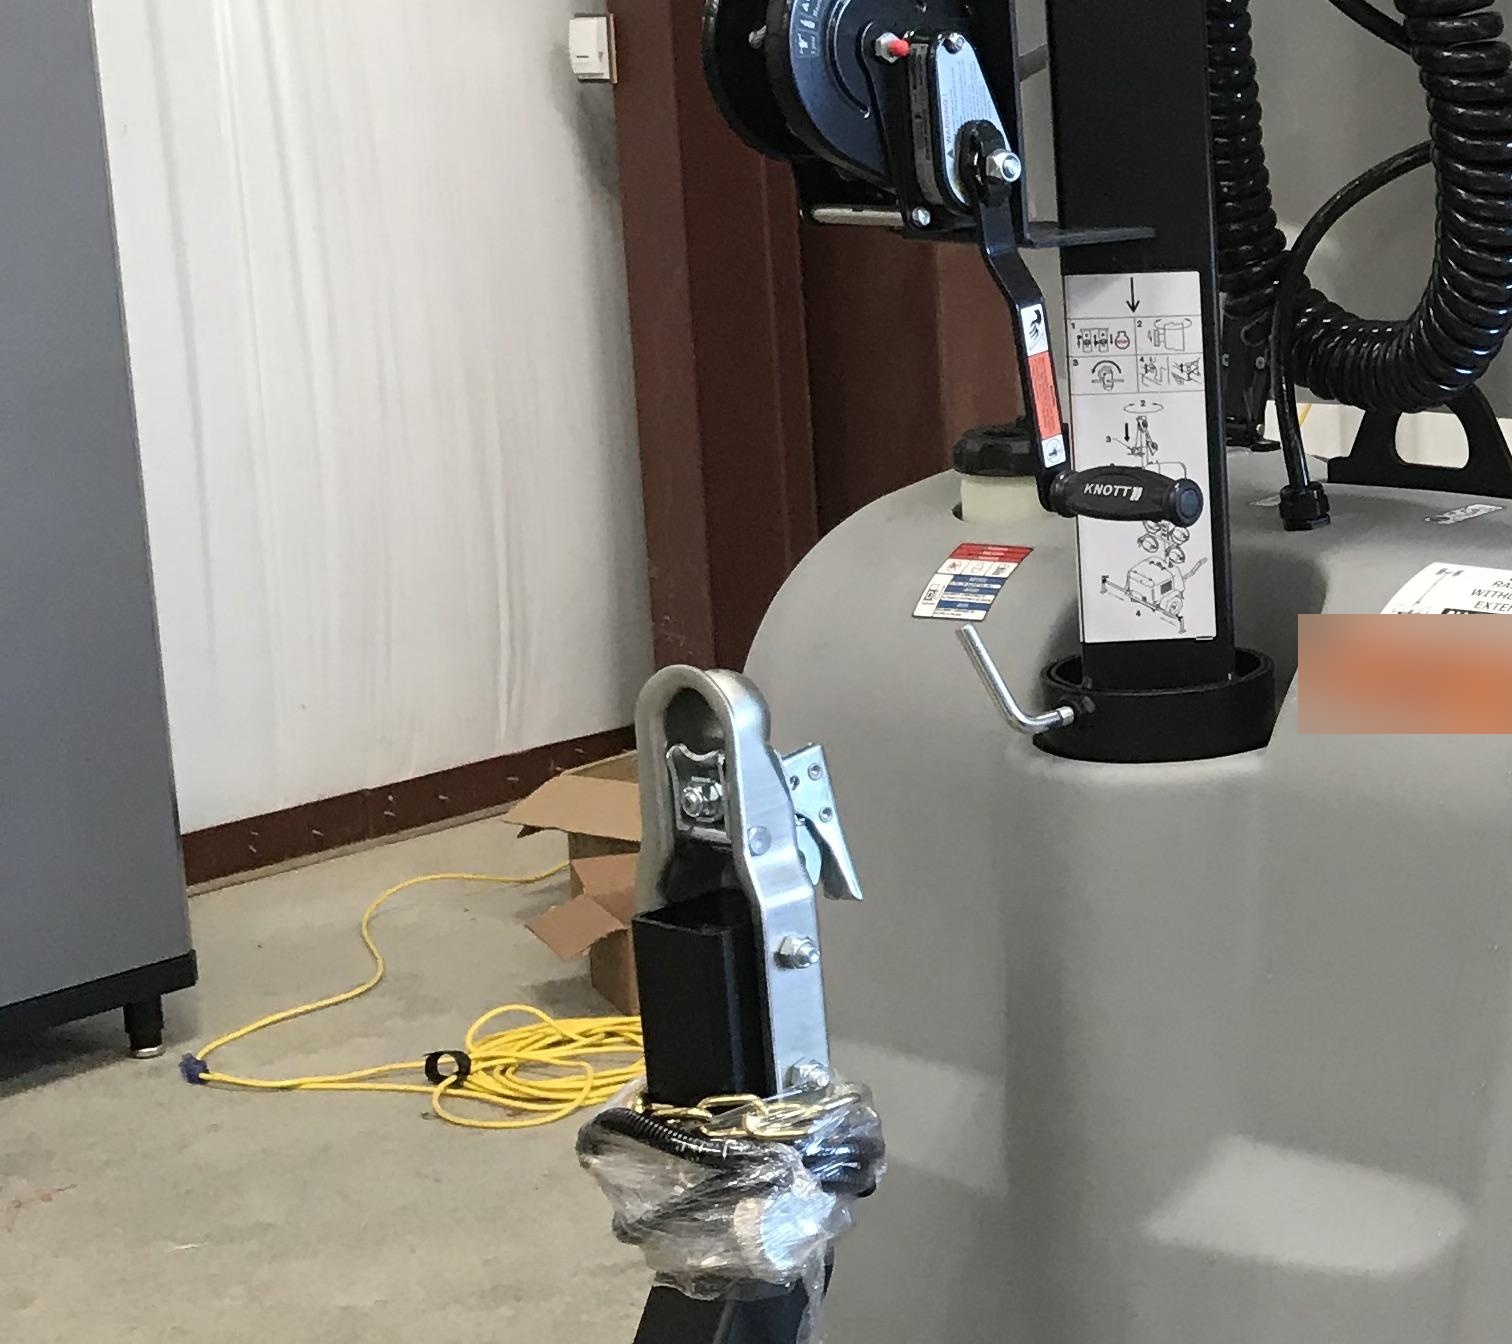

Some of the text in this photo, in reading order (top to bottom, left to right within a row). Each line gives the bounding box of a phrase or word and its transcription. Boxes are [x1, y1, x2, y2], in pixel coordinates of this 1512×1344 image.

[1137, 320, 1143, 328] 2
[1072, 359, 1079, 367] 3
[1140, 399, 1146, 407] 2
[1105, 435, 1112, 443] 3
[1083, 483, 1132, 497] KNOTT
